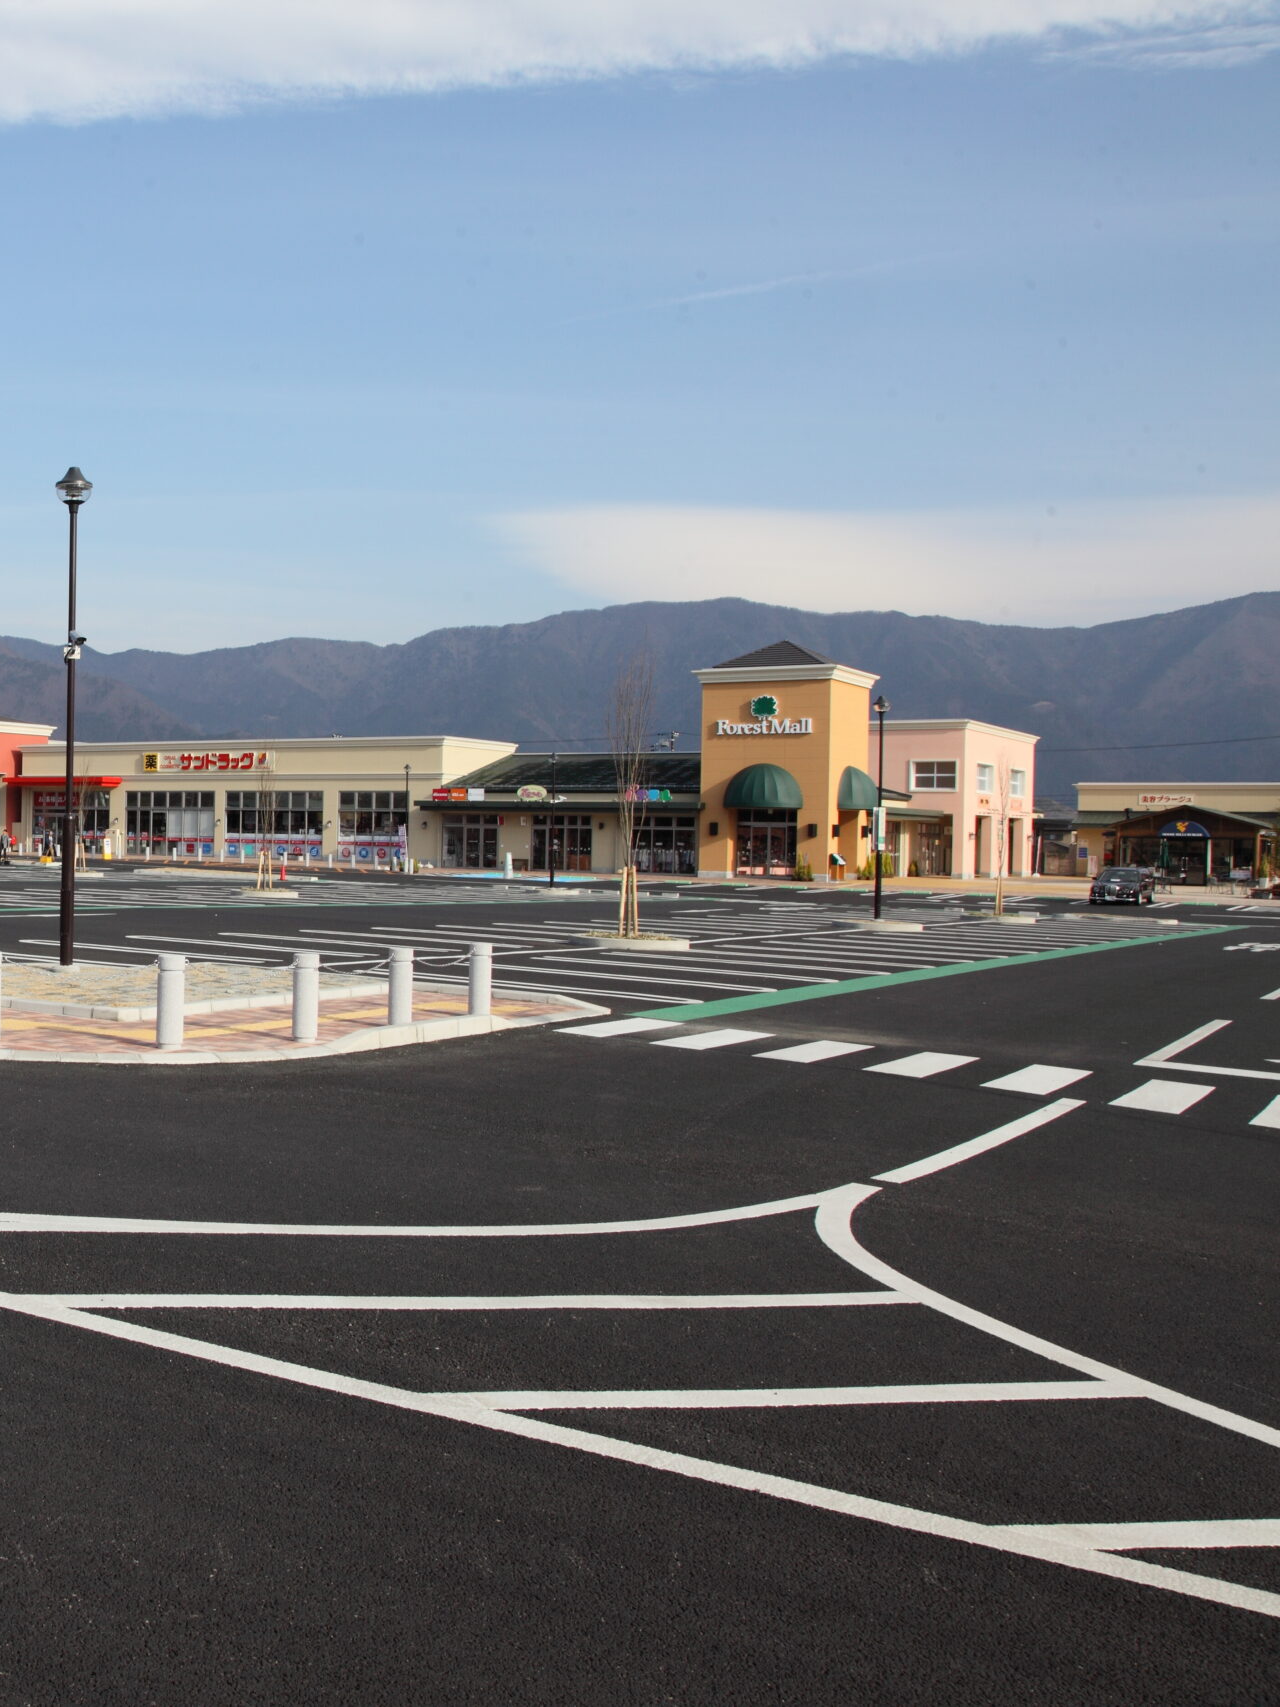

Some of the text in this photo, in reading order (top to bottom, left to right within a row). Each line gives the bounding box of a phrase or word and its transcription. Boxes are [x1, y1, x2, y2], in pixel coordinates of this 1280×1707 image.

[716, 718, 813, 735] Forest Mall
[145, 754, 157, 769] 薬
[180, 752, 254, 771] サンドラッグ
